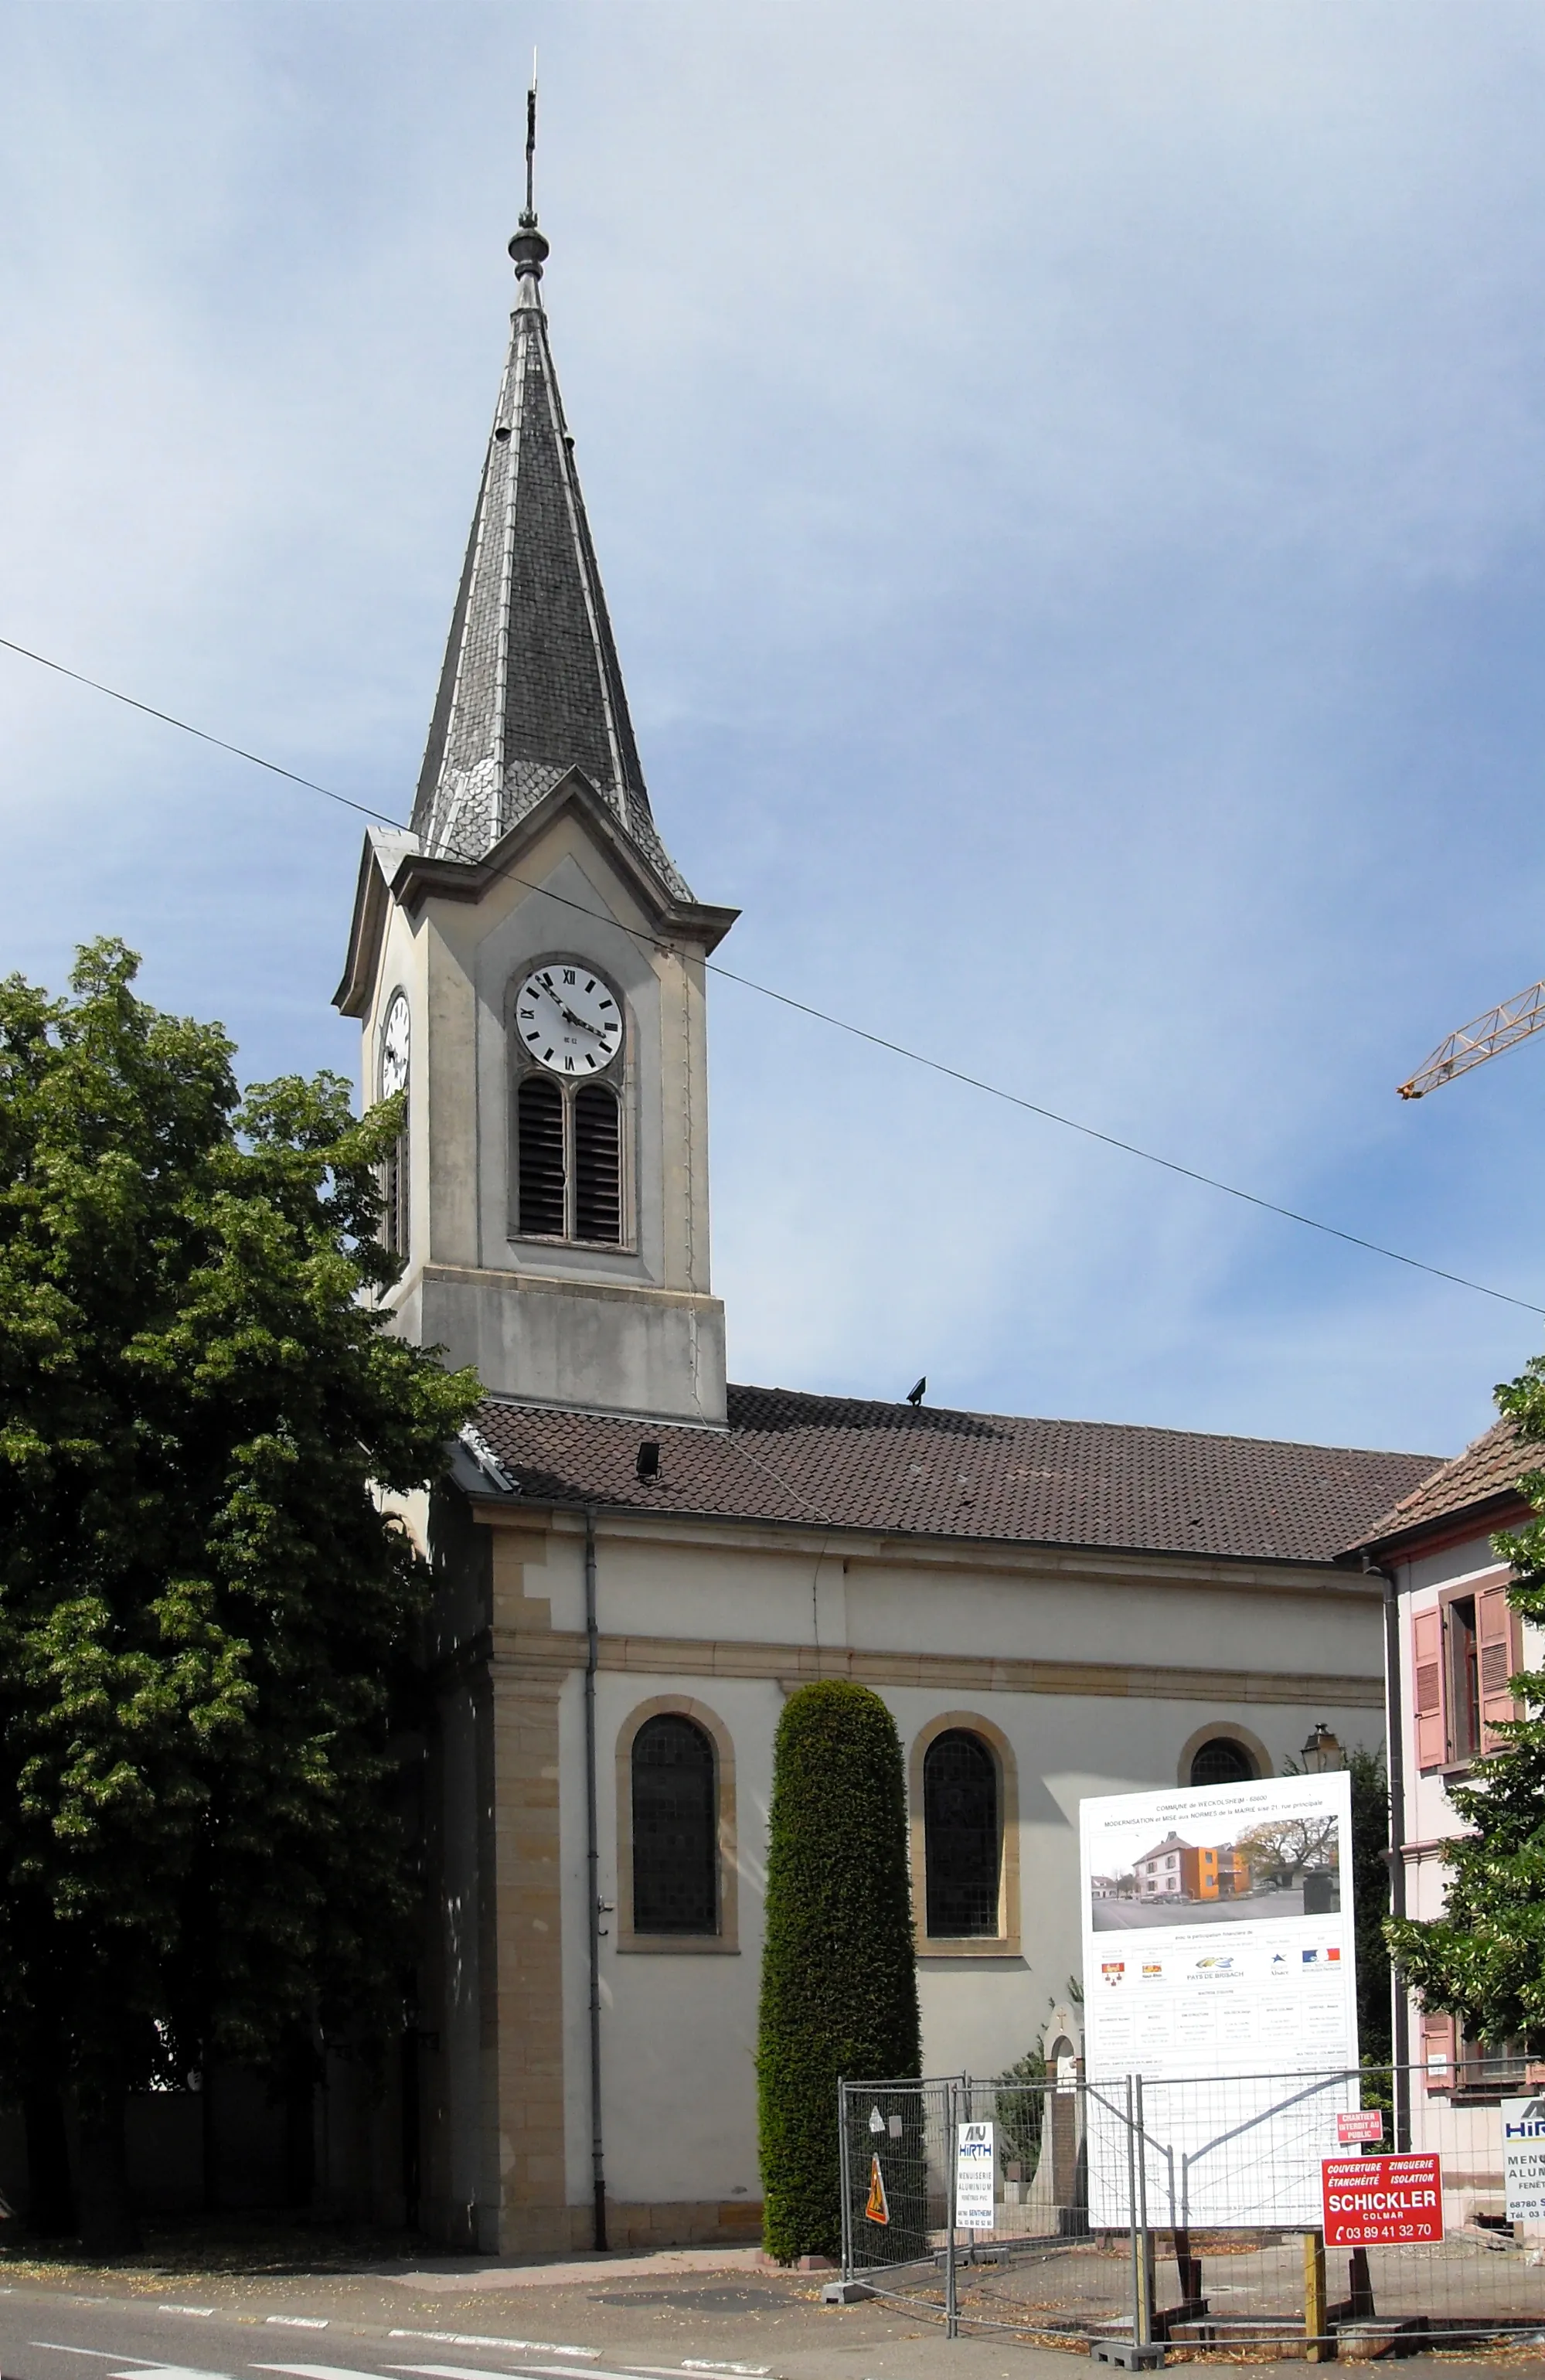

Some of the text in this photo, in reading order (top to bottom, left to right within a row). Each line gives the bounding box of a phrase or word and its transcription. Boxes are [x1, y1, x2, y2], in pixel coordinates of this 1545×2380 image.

[1104, 1817, 1154, 1827] MODERNISATION
[1190, 1810, 1217, 1819] NORMES
[1293, 1799, 1323, 1809] principale
[1342, 2113, 1376, 2122] CHANTIER
[1339, 2122, 1368, 2131] INTERDIT
[1347, 2130, 1372, 2140] PUBLIC
[1327, 2162, 1382, 2174] COUVERTURE
[1388, 2159, 1434, 2171] ZINGUERIE
[1328, 2173, 1435, 2188] ÉTANCHÉITÉ ISOLATION
[958, 2182, 992, 2191] ALUMINIUM
[1328, 2190, 1437, 2212] SCHICKLER
[1509, 2200, 1536, 2208] 68780
[1363, 2211, 1404, 2221] COLMAR
[1510, 2211, 1526, 2219] Tél.
[1346, 2223, 1431, 2239] 03 89 41 32 70
